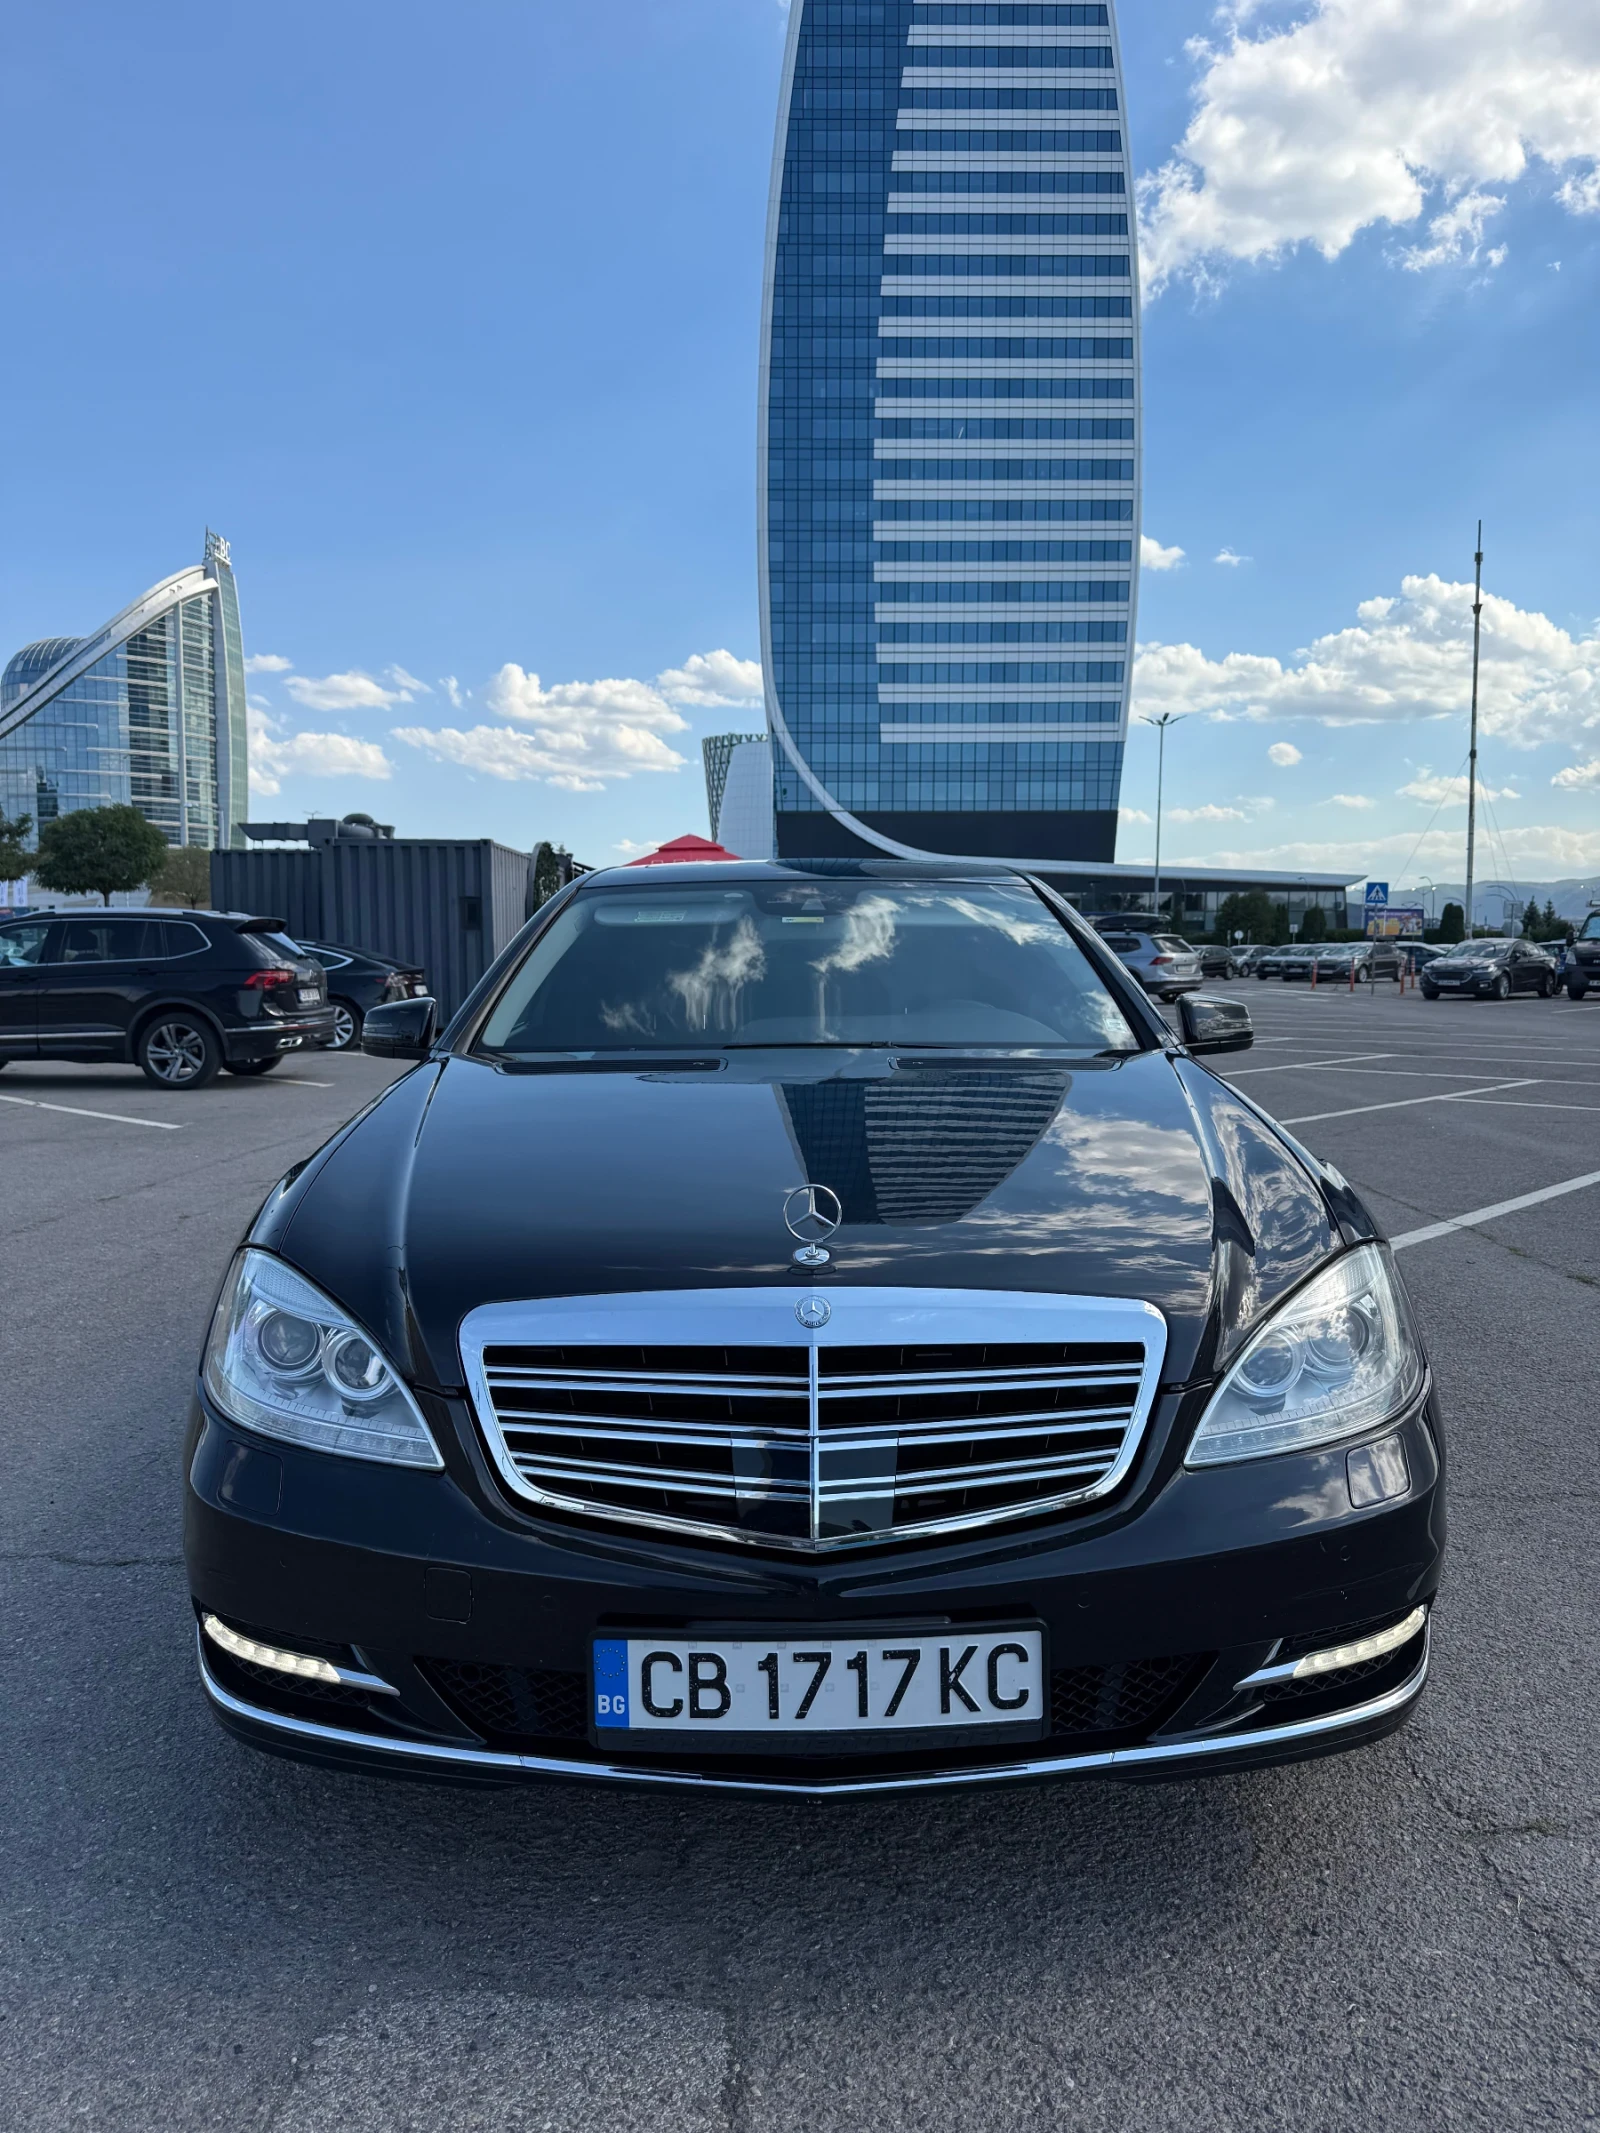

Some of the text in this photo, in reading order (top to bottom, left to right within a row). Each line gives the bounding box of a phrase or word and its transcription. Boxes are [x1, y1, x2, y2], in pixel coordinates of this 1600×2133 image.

[597, 1694, 626, 1715] BG
[641, 1643, 1030, 1719] CB 1717 KC
